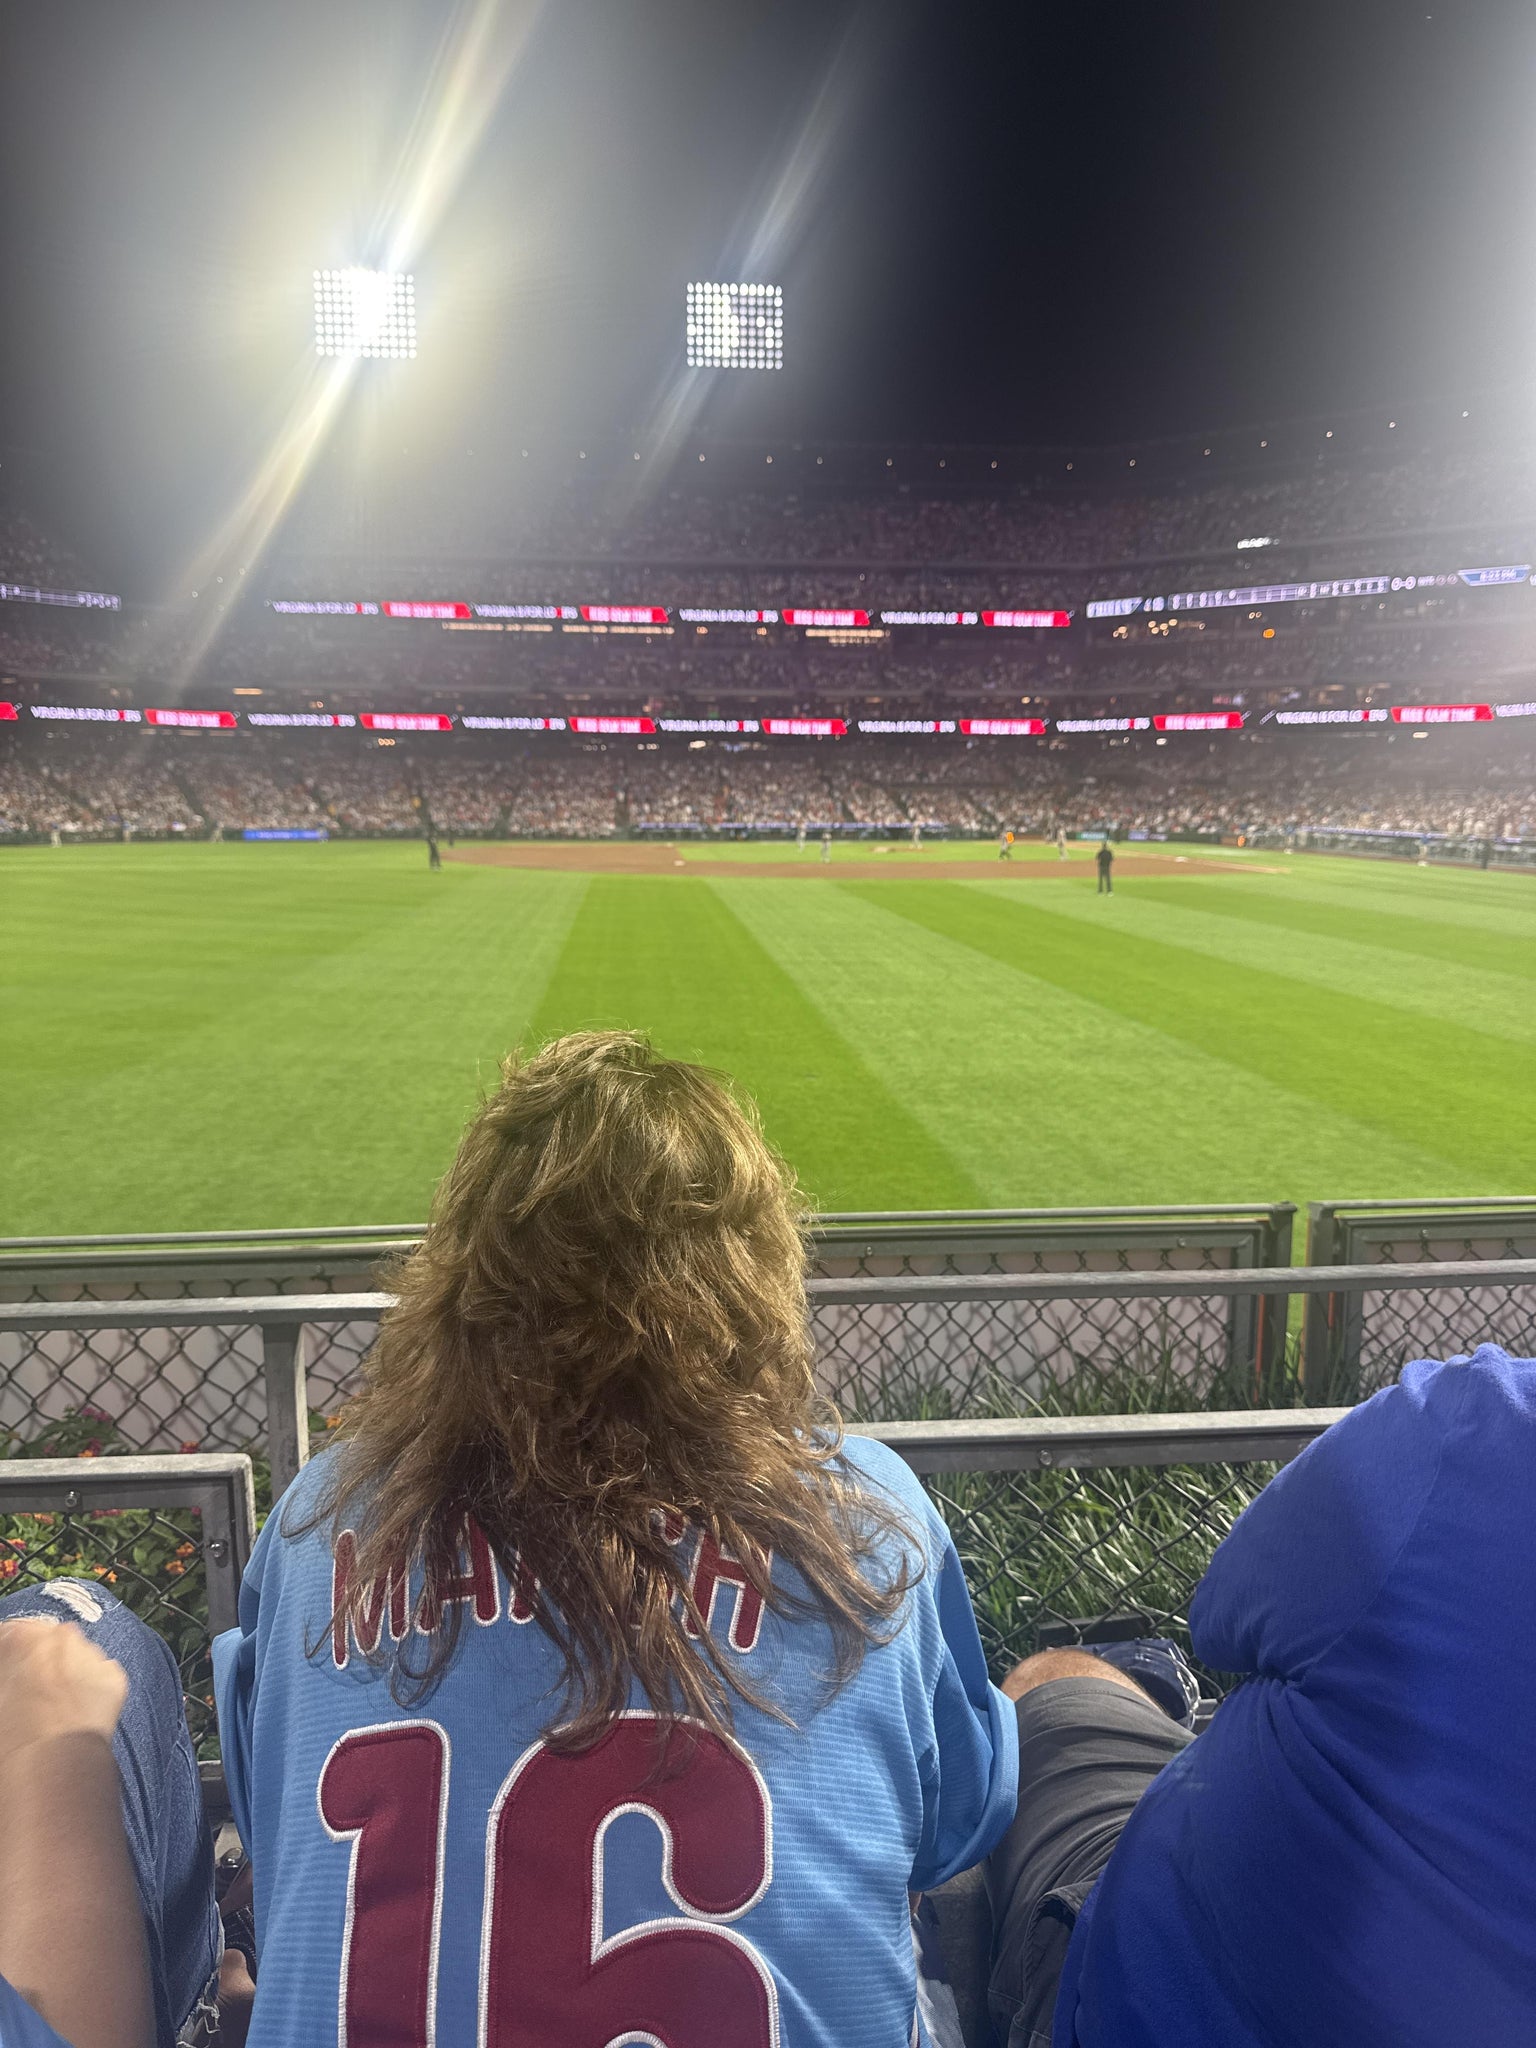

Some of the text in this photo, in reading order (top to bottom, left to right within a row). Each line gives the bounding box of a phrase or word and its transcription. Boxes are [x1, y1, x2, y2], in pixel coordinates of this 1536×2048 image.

[1276, 711, 1318, 724] VIRGINIA
[332, 1509, 773, 1670] MAH
[317, 1709, 779, 2048] 16
